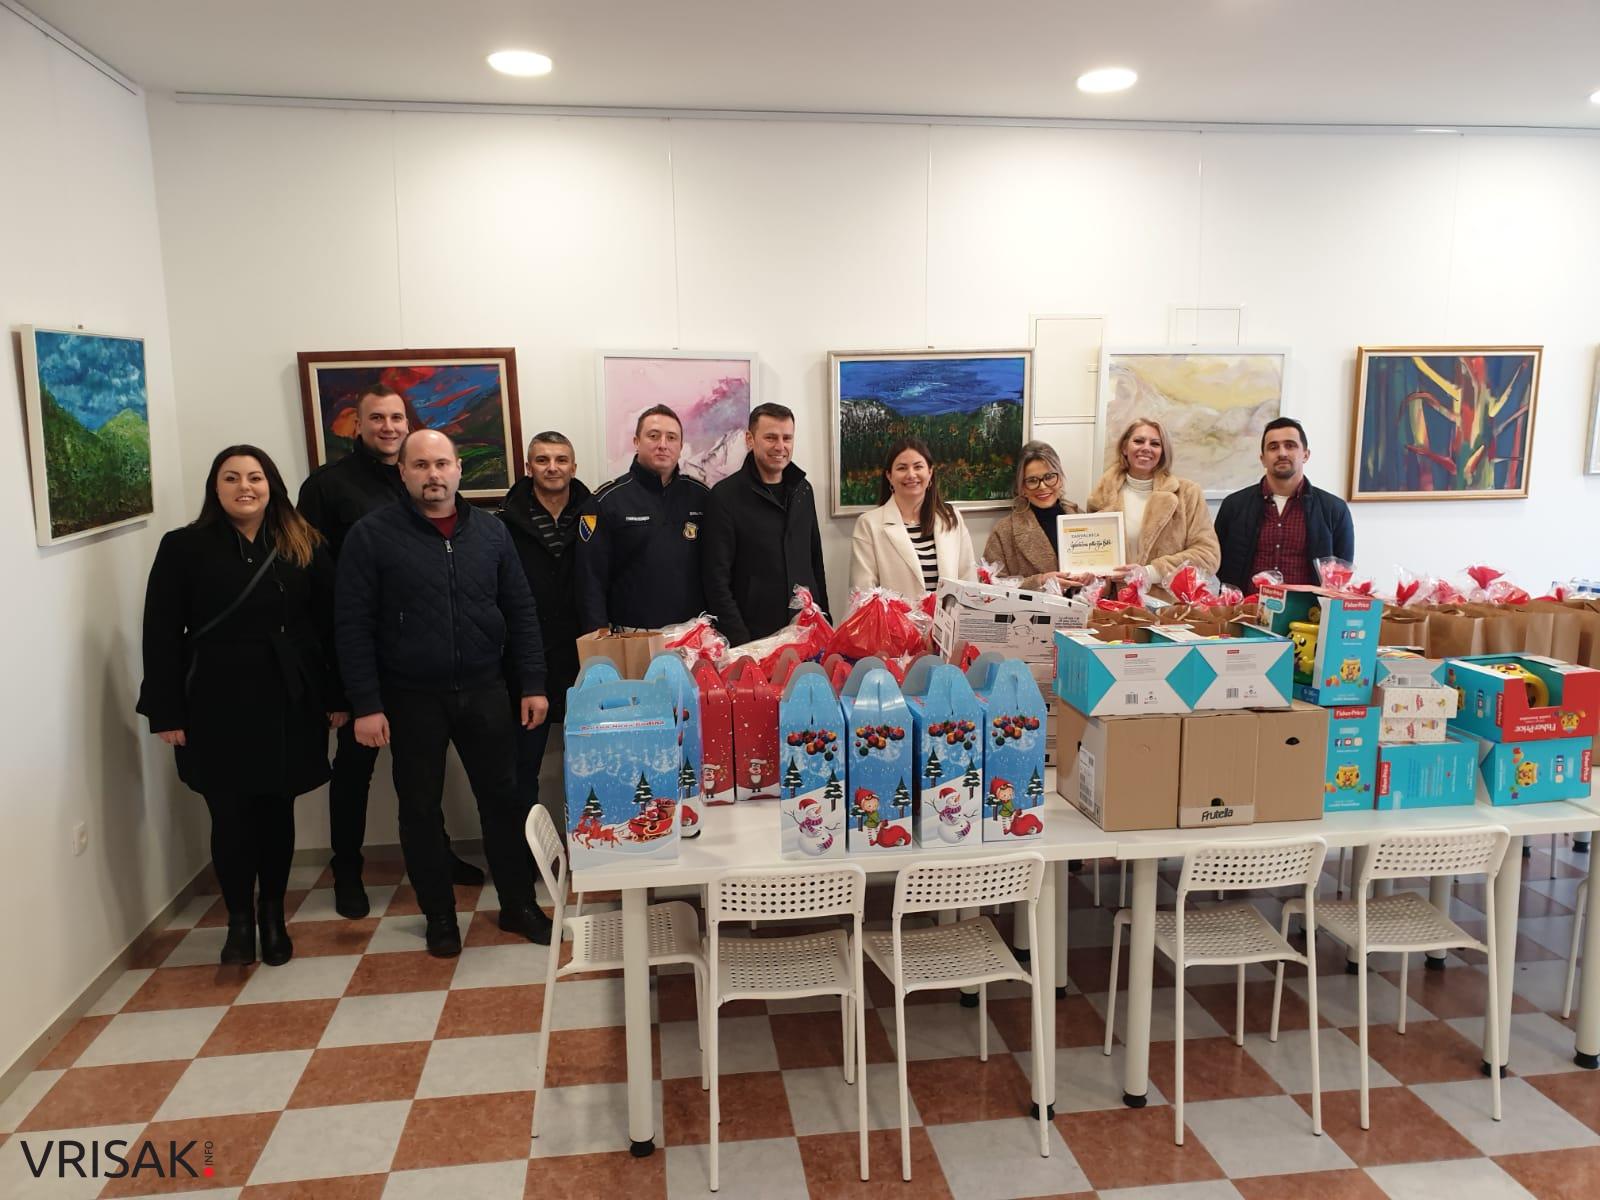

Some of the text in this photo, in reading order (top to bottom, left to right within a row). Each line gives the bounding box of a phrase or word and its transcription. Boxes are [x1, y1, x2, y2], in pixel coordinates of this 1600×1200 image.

[1335, 709, 1365, 717] Fisher-Price
[1513, 723, 1556, 734] Fisher-Price
[1201, 807, 1234, 822] Frutella
